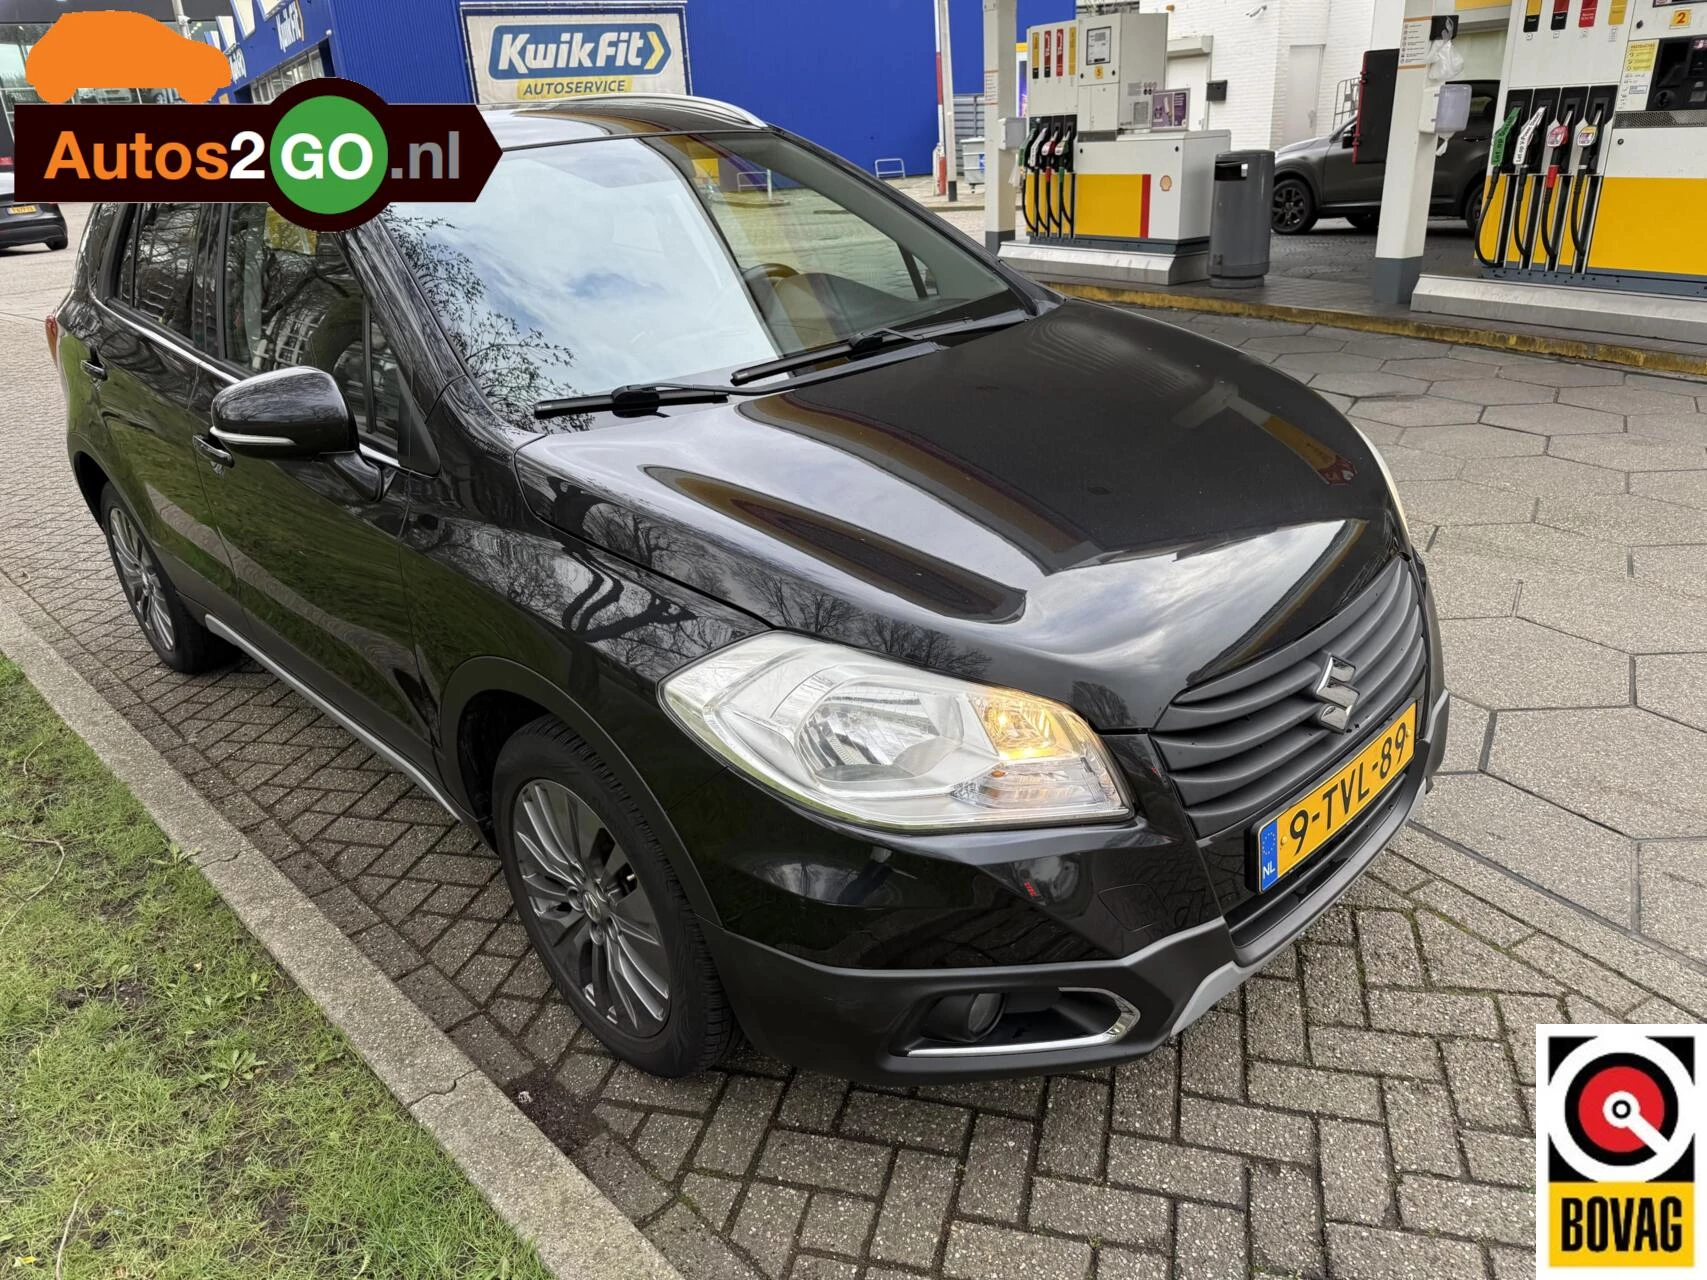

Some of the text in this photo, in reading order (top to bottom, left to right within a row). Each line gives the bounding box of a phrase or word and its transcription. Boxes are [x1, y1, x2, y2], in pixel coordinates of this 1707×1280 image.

[1676, 12, 1686, 24] 2
[523, 80, 626, 96] AUTOSERVICE
[1289, 721, 1407, 856] 9-TVL-89
[1262, 861, 1276, 880] NL
